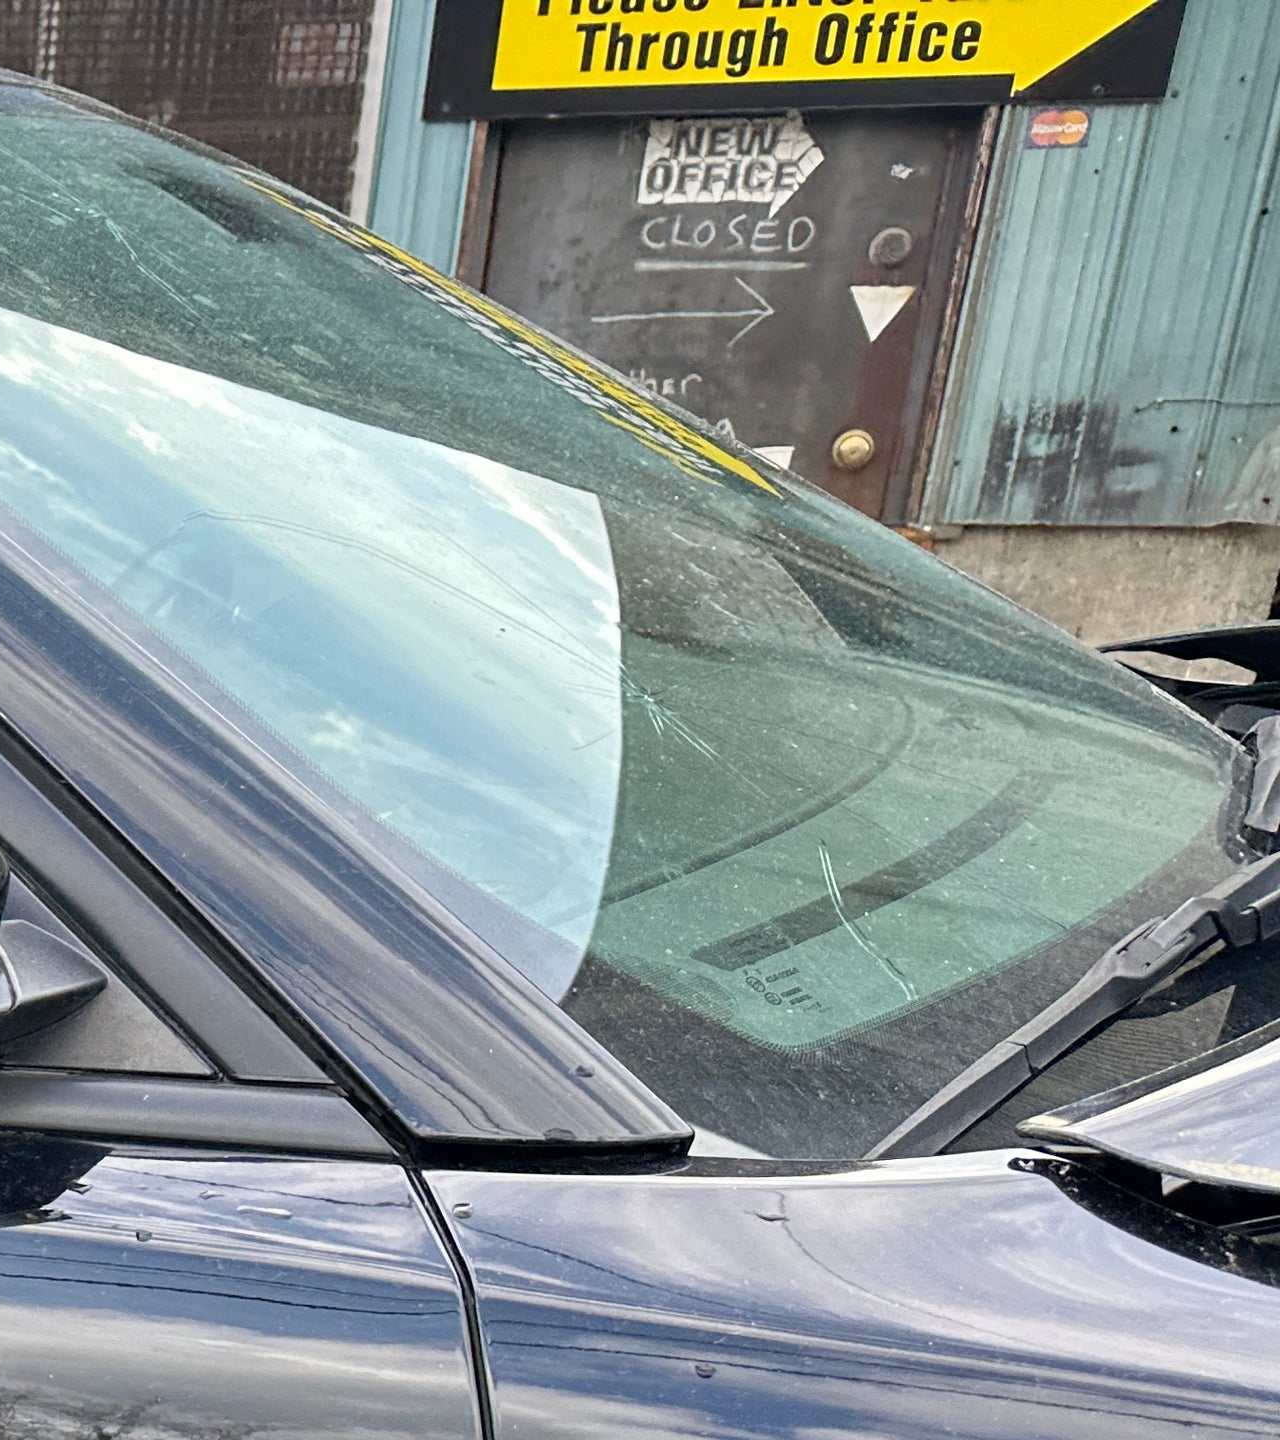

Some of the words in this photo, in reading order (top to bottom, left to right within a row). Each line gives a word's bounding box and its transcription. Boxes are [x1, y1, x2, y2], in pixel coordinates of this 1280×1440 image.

[576, 17, 788, 77] Through
[814, 11, 982, 66] Office
[672, 121, 776, 157] NEW
[646, 157, 798, 193] OFFICE
[642, 214, 816, 251] CLOSED
